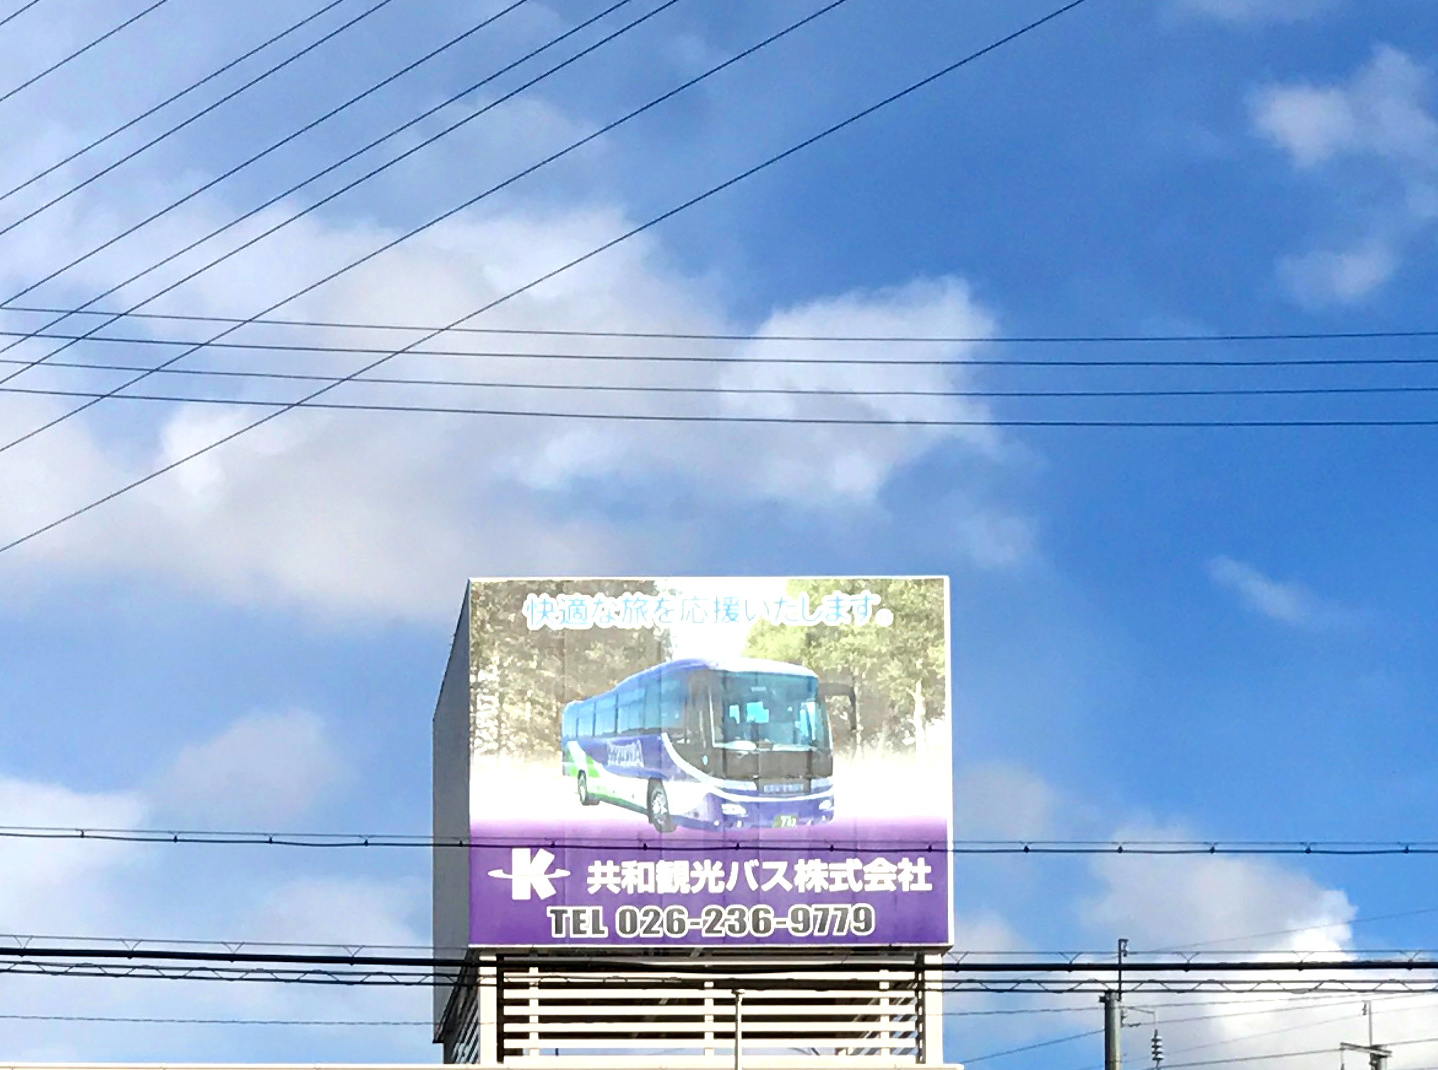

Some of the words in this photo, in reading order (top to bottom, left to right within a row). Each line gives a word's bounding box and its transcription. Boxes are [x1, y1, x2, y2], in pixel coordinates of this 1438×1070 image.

[526, 594, 893, 628] 快適な旅を応援いたします。
[587, 858, 932, 894] 共和観光バス株式会社
[547, 904, 608, 938] TEL
[616, 903, 876, 938] 026-236-9779
